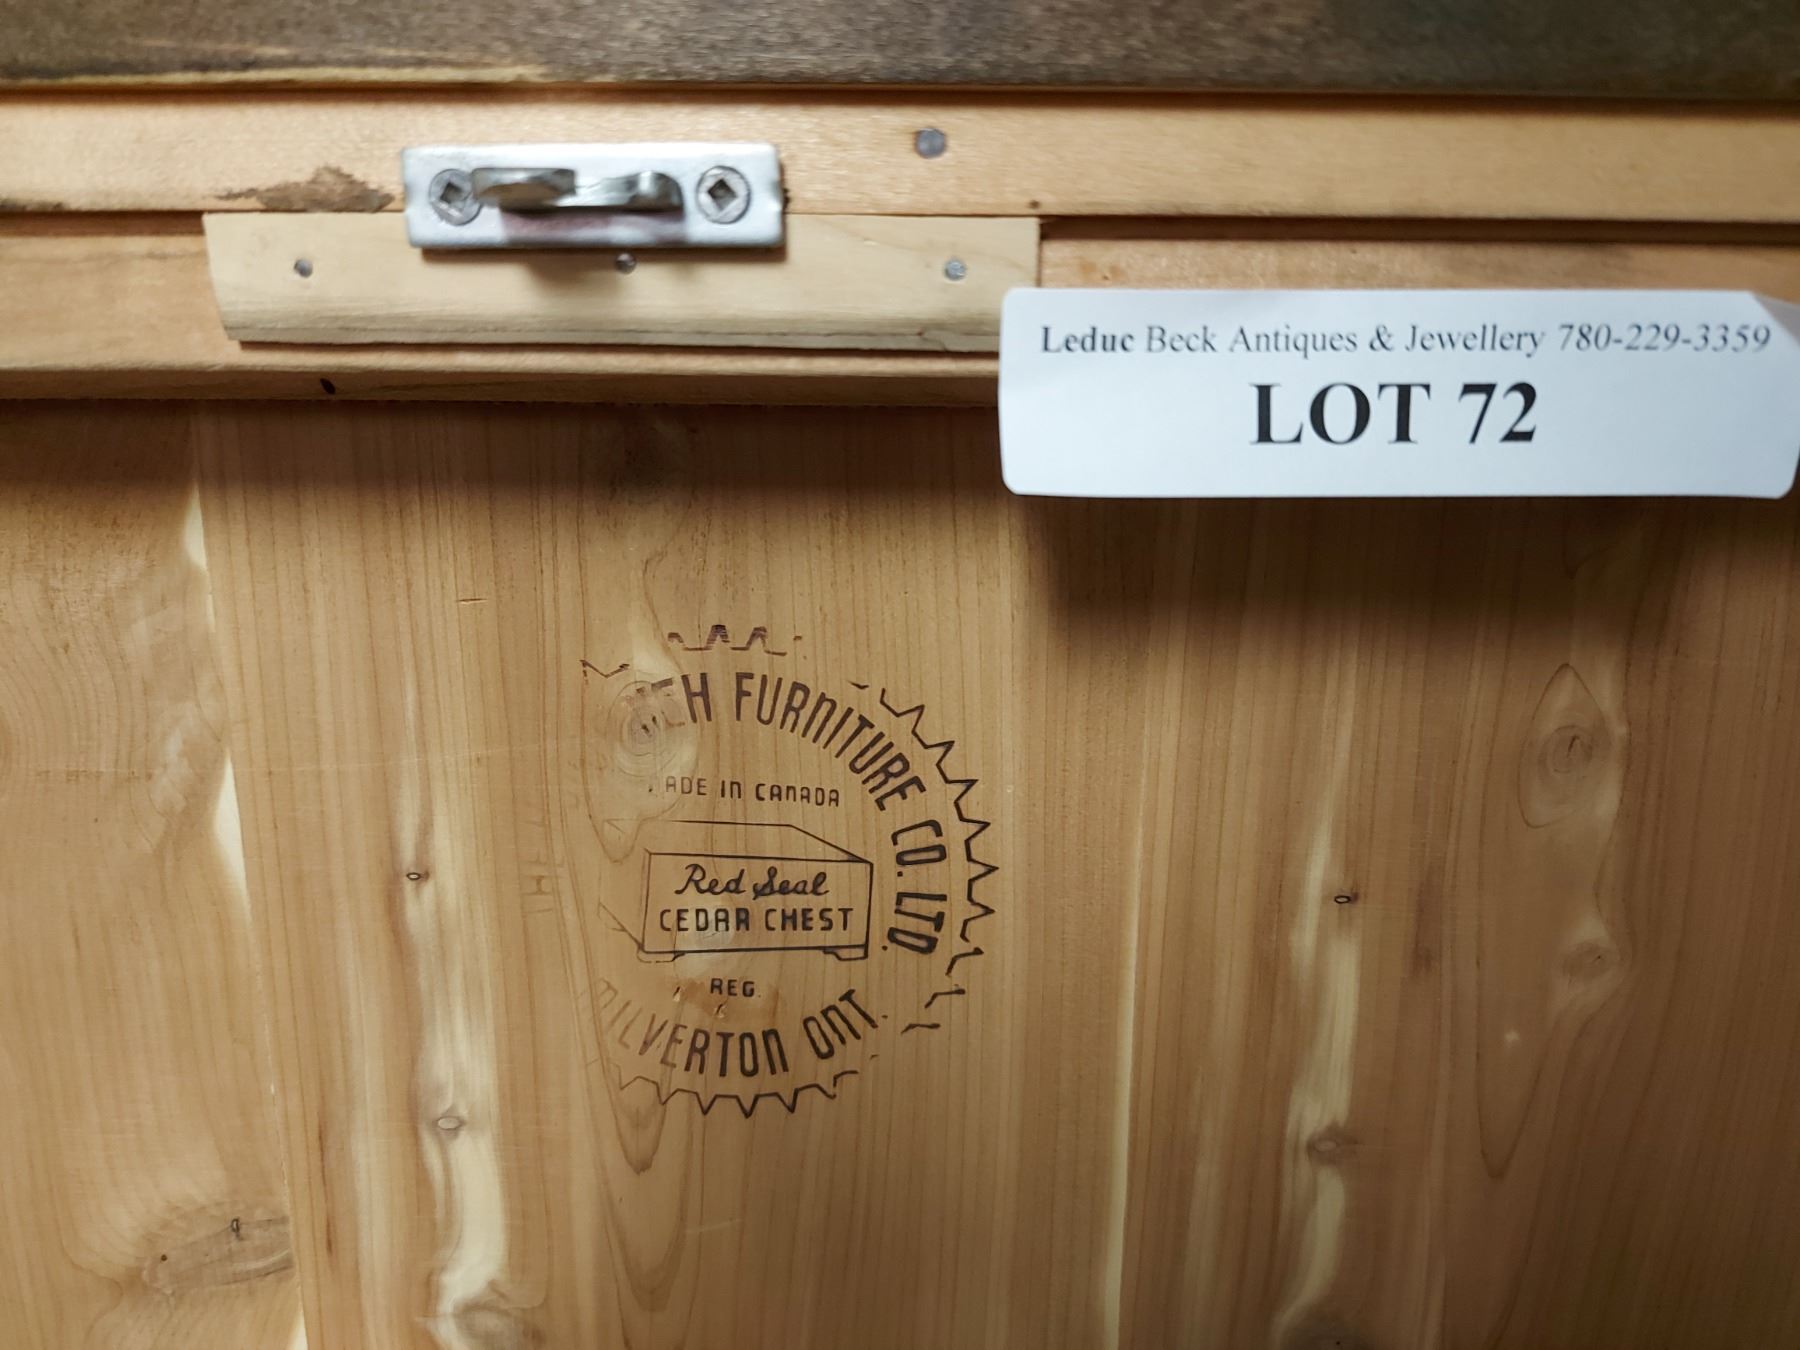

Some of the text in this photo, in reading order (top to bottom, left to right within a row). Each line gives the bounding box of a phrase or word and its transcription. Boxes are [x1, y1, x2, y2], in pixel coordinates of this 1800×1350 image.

[1041, 323, 1773, 358] Leduc Beck Antiques & Jewellery 780-229-3359
[1251, 381, 1538, 444] LOT 72
[735, 672, 926, 811] FURNITURE
[648, 775, 840, 807] ADE IN CANADA
[674, 863, 829, 900] Red Seal
[659, 908, 853, 932] CEDAR CHEST
